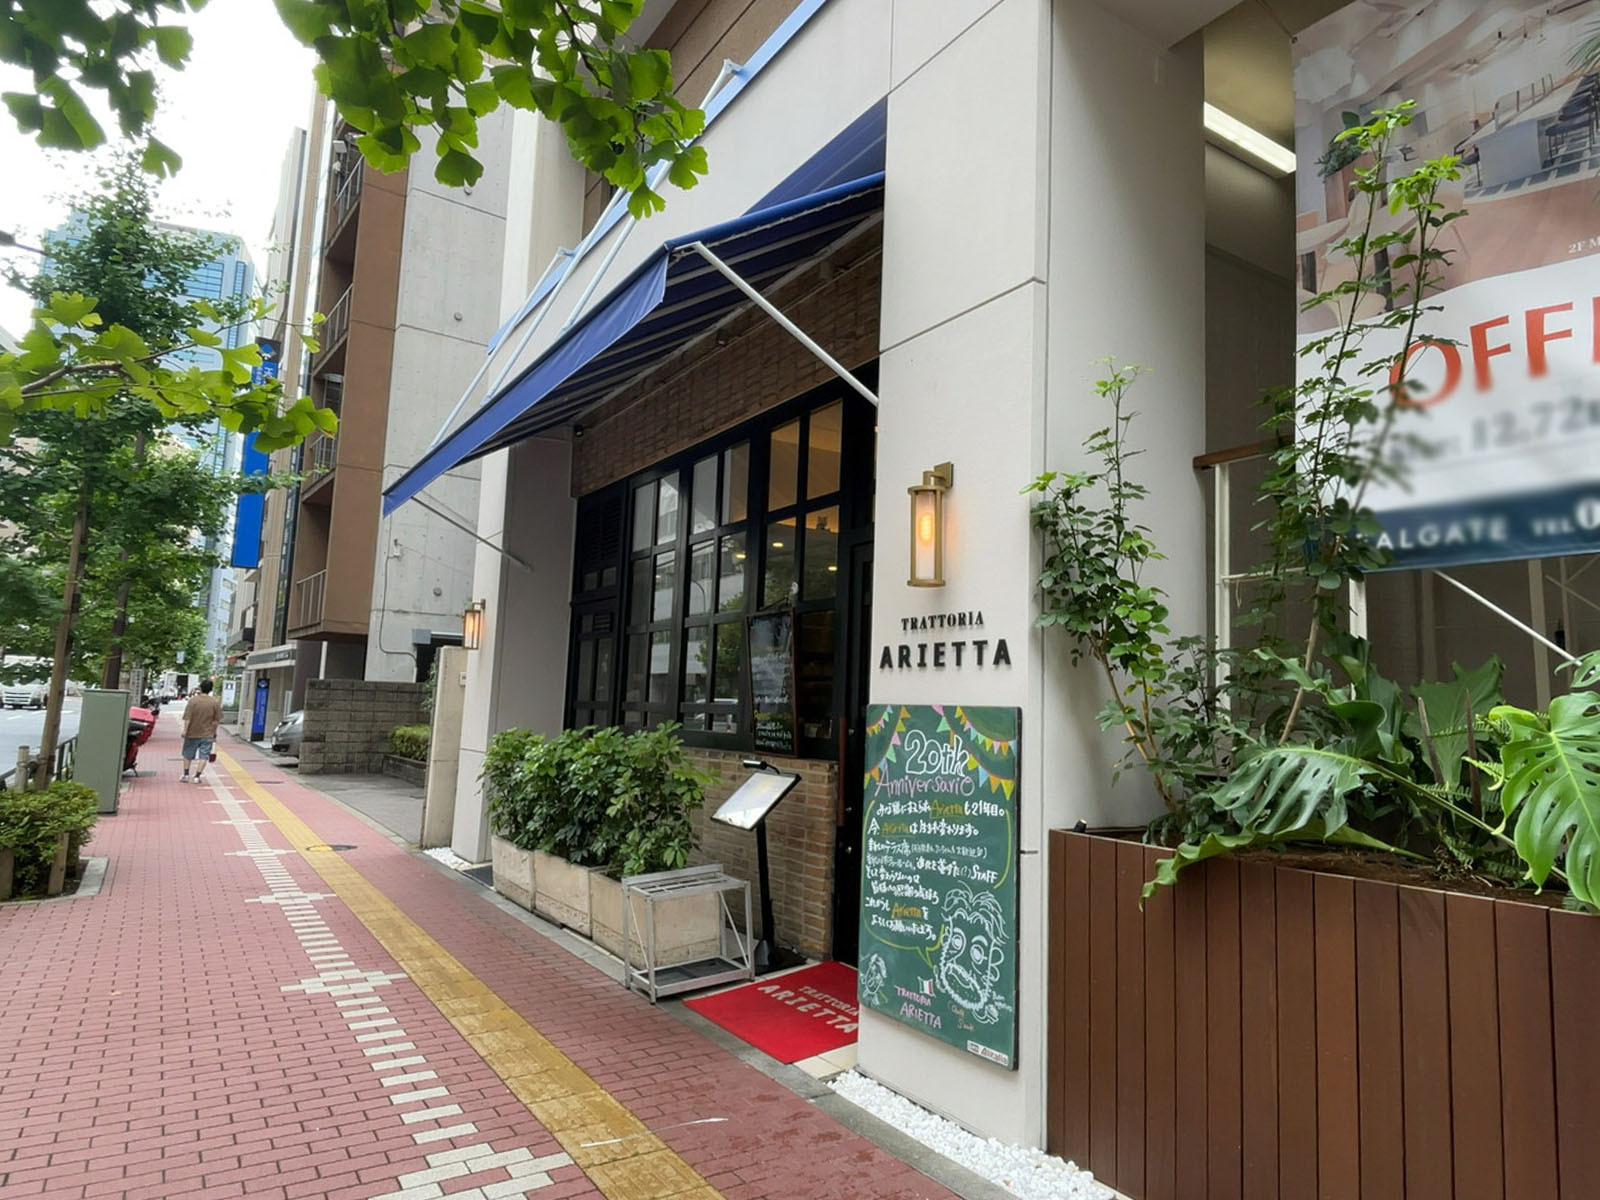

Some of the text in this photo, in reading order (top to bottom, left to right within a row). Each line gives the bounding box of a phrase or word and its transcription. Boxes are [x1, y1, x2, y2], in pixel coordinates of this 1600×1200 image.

[1530, 517, 1574, 538] TEL
[901, 610, 984, 631] TRATTORIA
[879, 638, 1011, 670] ARIETTA
[904, 729, 970, 777] 20th
[757, 984, 858, 1033] ARIETTA
[899, 1001, 942, 1030] ARIETTA
